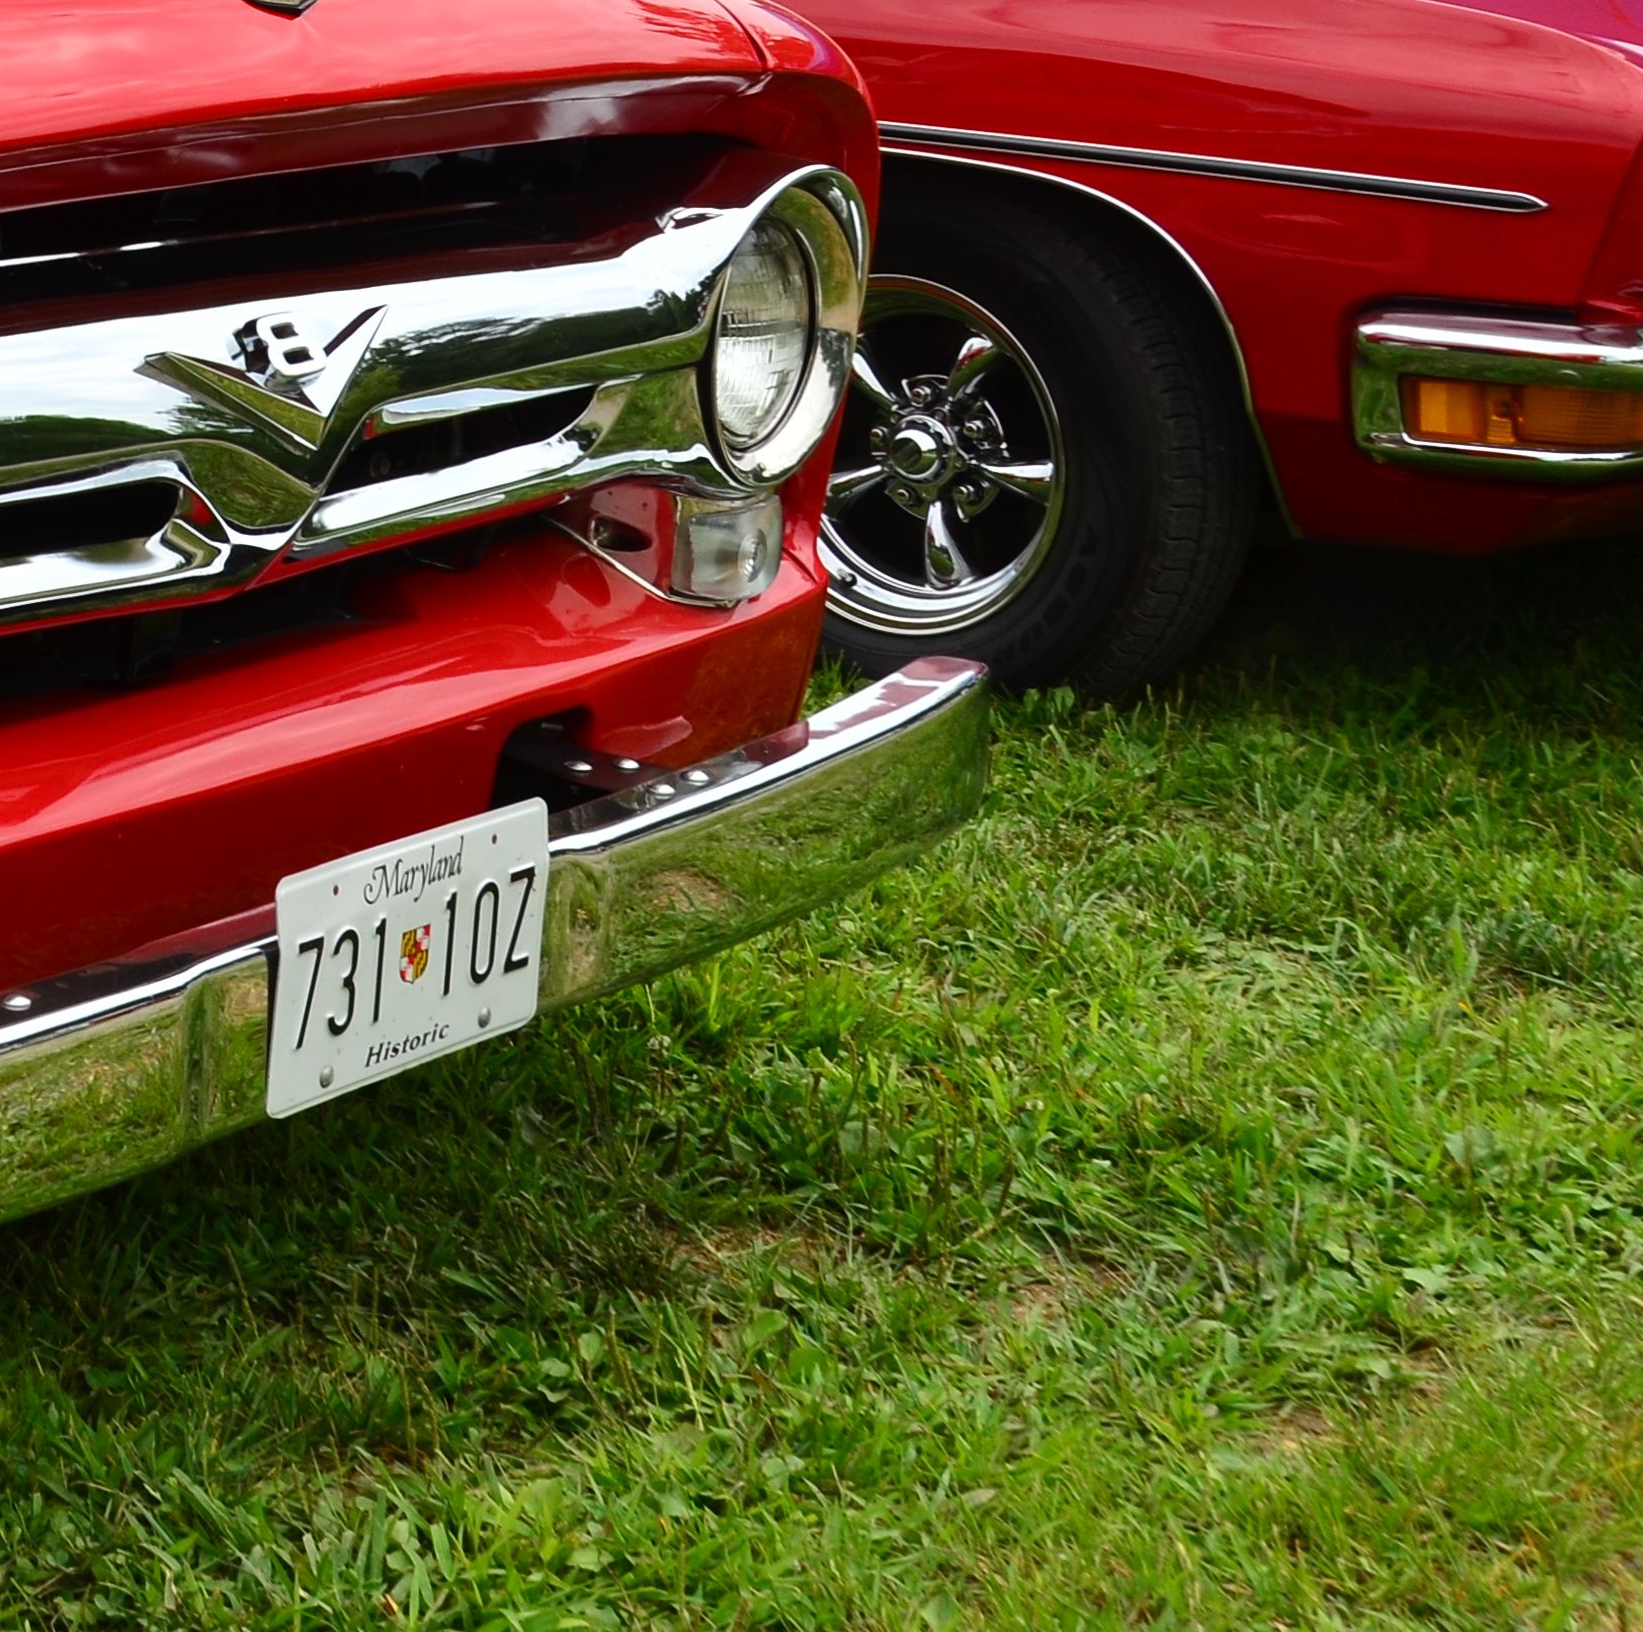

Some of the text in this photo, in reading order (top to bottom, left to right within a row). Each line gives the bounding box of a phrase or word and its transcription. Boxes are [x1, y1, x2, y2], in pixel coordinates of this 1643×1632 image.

[363, 836, 465, 906] Maryland
[295, 918, 388, 1051] 731
[365, 1022, 450, 1068] Historic
